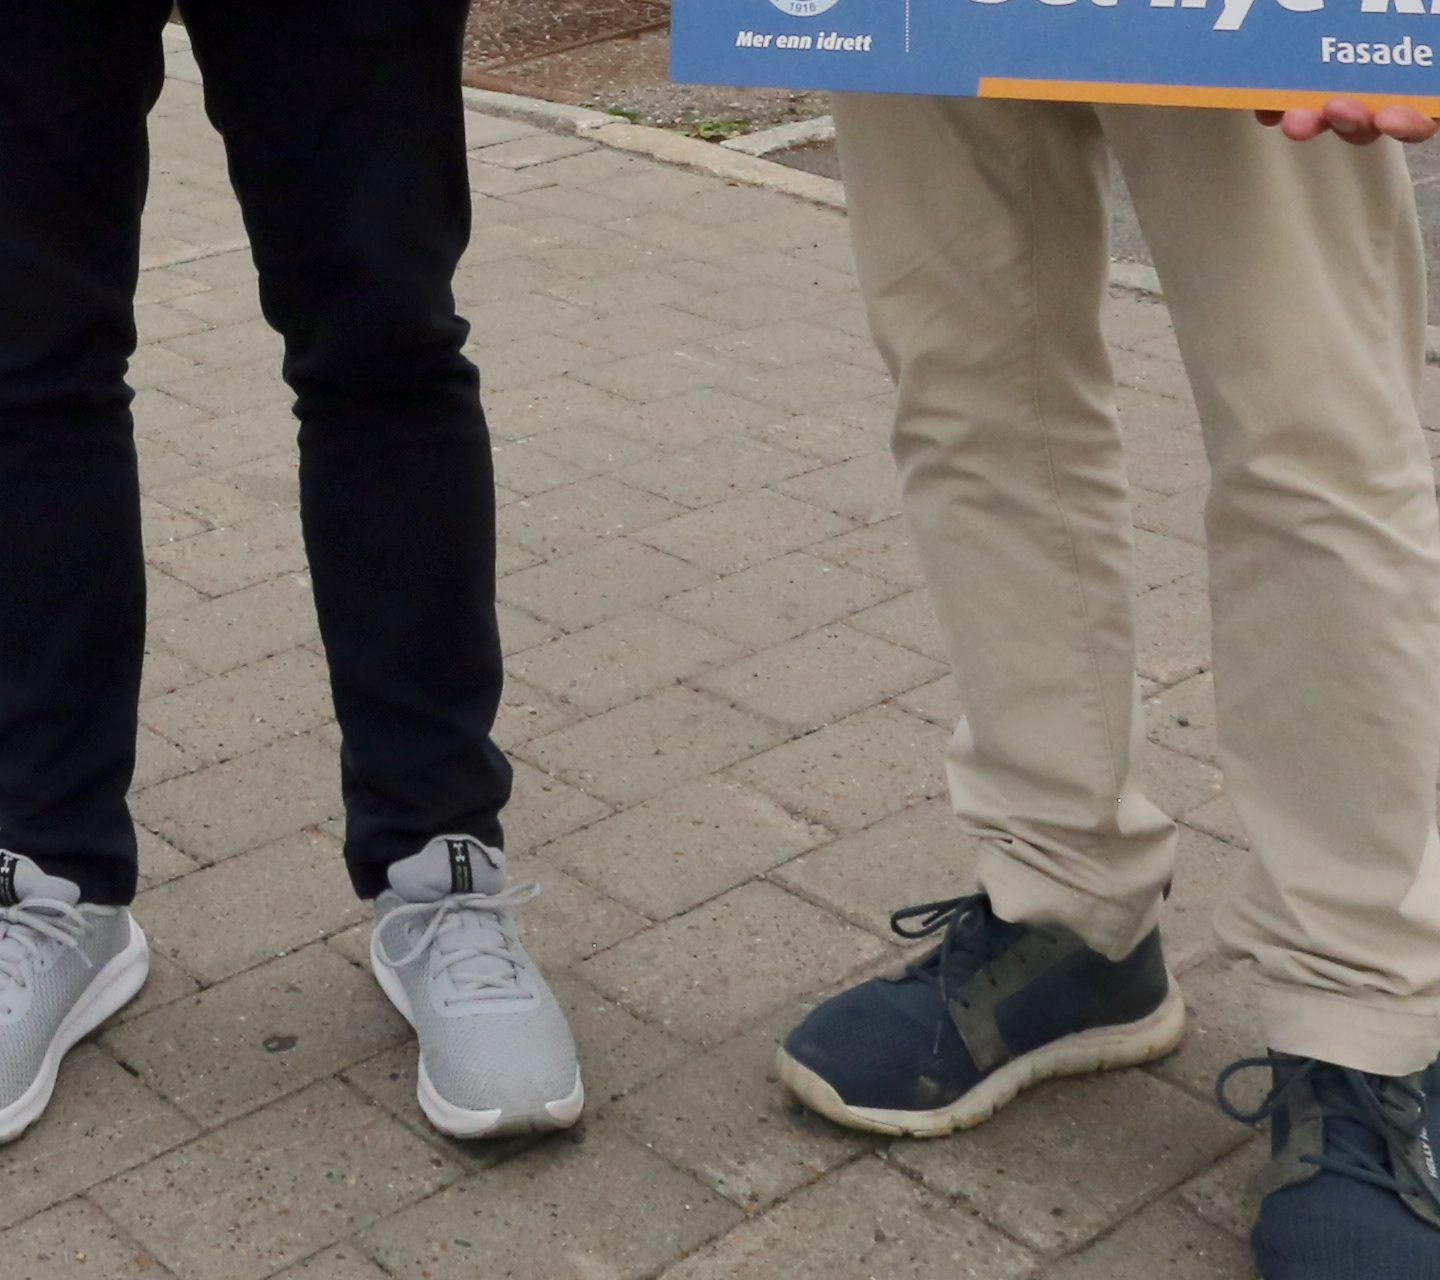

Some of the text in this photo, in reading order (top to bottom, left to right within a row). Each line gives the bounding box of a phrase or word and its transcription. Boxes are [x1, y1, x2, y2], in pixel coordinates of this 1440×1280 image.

[790, 2, 817, 13] 1916
[736, 31, 872, 51] Mer enn idrett
[1322, 36, 1433, 66] Fasade
